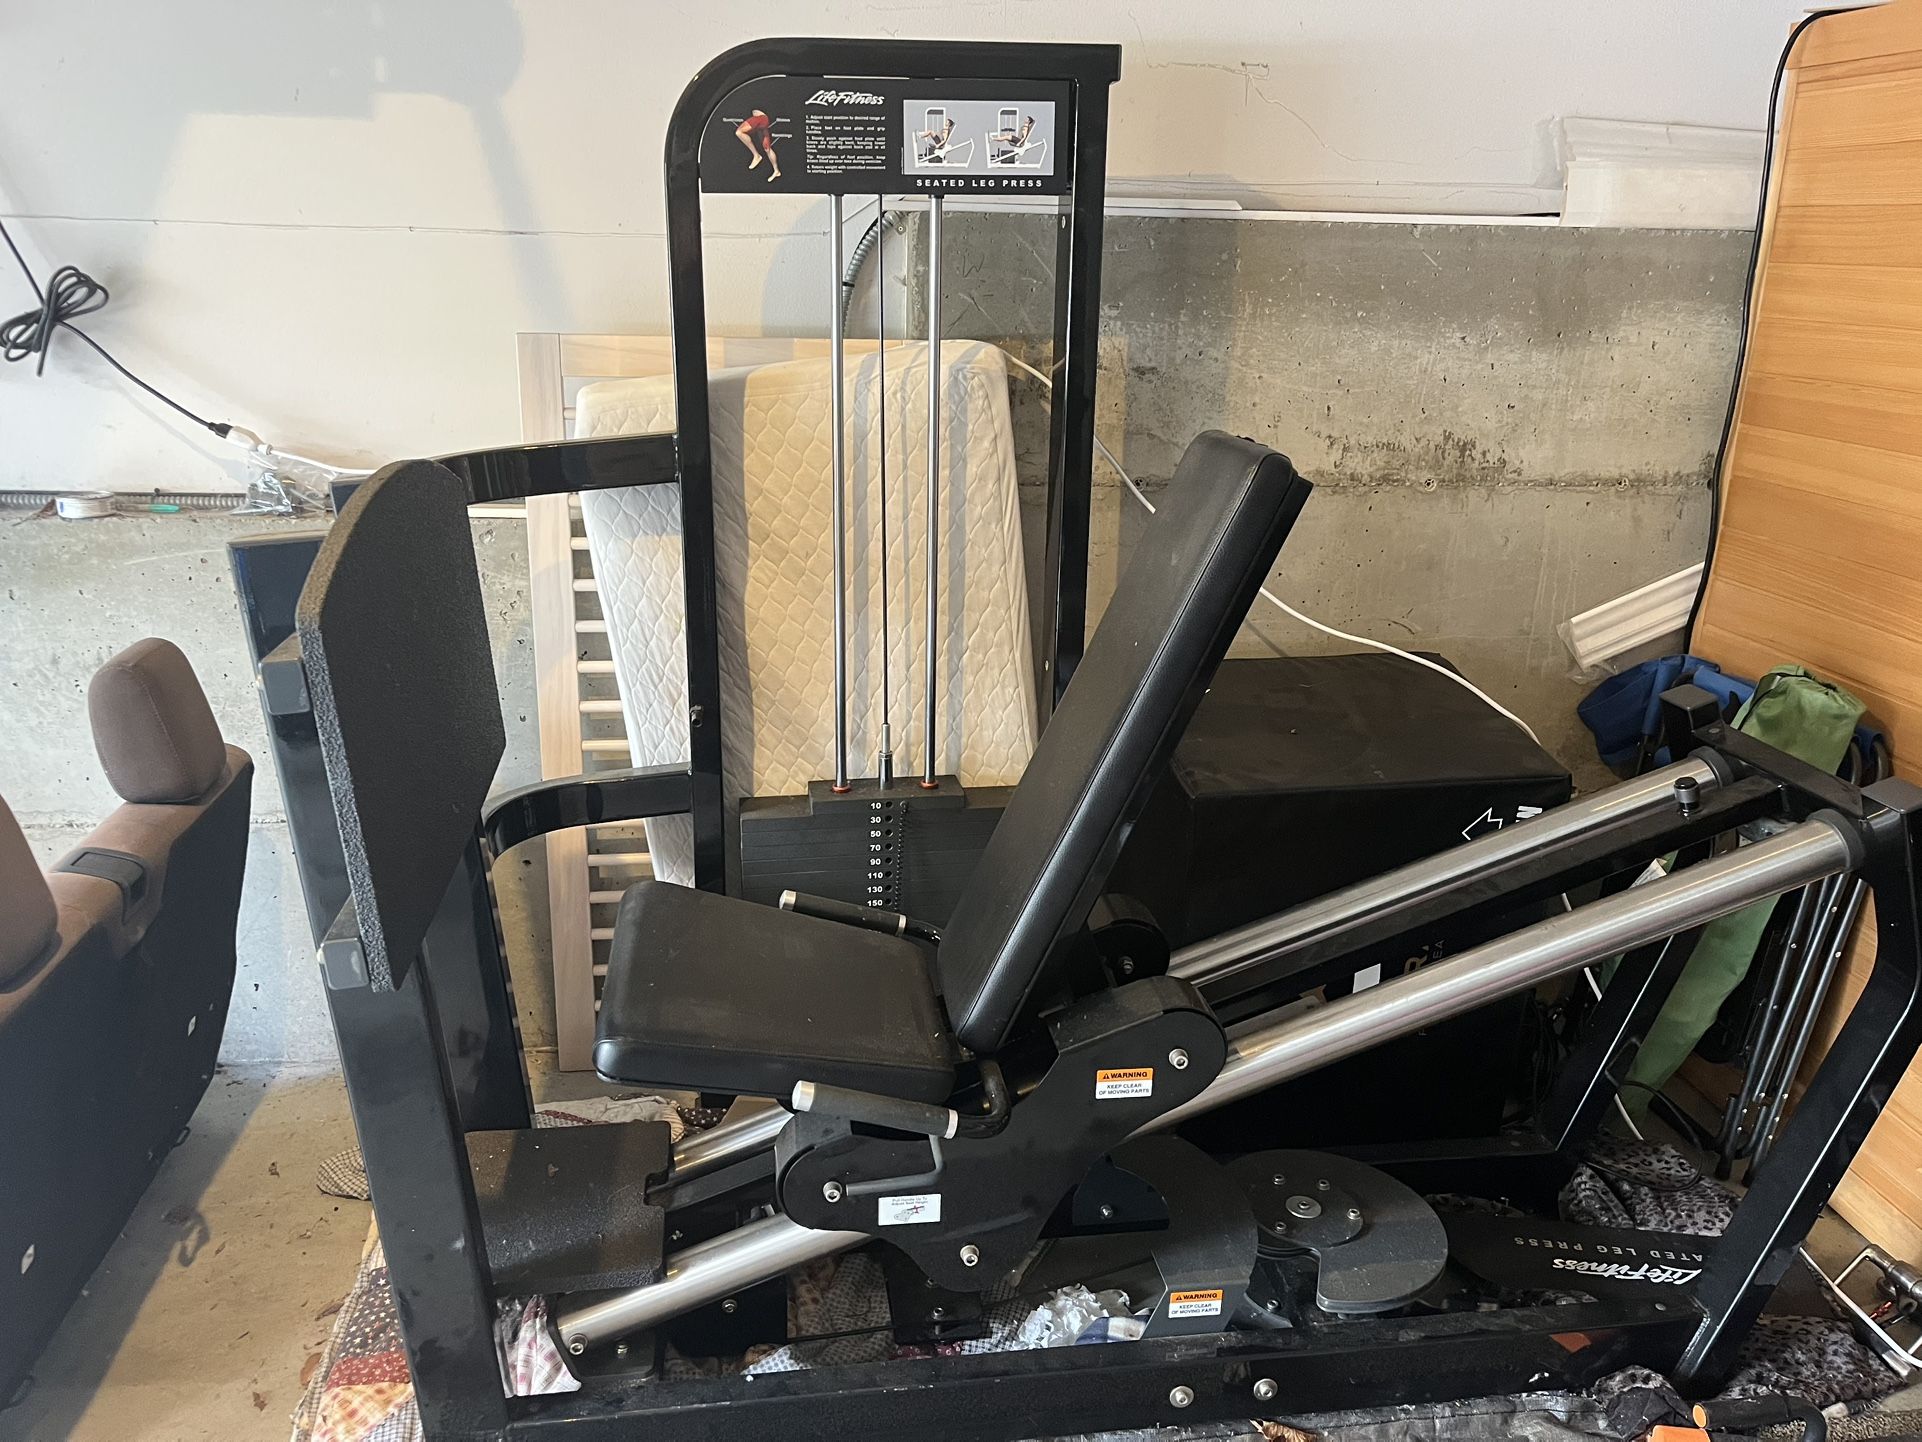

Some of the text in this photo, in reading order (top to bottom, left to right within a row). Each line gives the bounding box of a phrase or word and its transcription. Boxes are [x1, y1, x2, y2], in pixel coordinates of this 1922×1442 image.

[805, 90, 885, 106] LifeFitness
[916, 179, 1043, 187] SEATED LEG PRESS
[870, 802, 882, 810] 10
[870, 816, 882, 824] 30
[870, 830, 882, 838] 50
[869, 844, 881, 852] 70
[869, 858, 882, 866] 90
[867, 872, 884, 880] 110
[867, 886, 883, 894] 130
[1514, 1237, 1703, 1262] ATED LEG PRESS
[1552, 1258, 1702, 1285] LifeFitness
